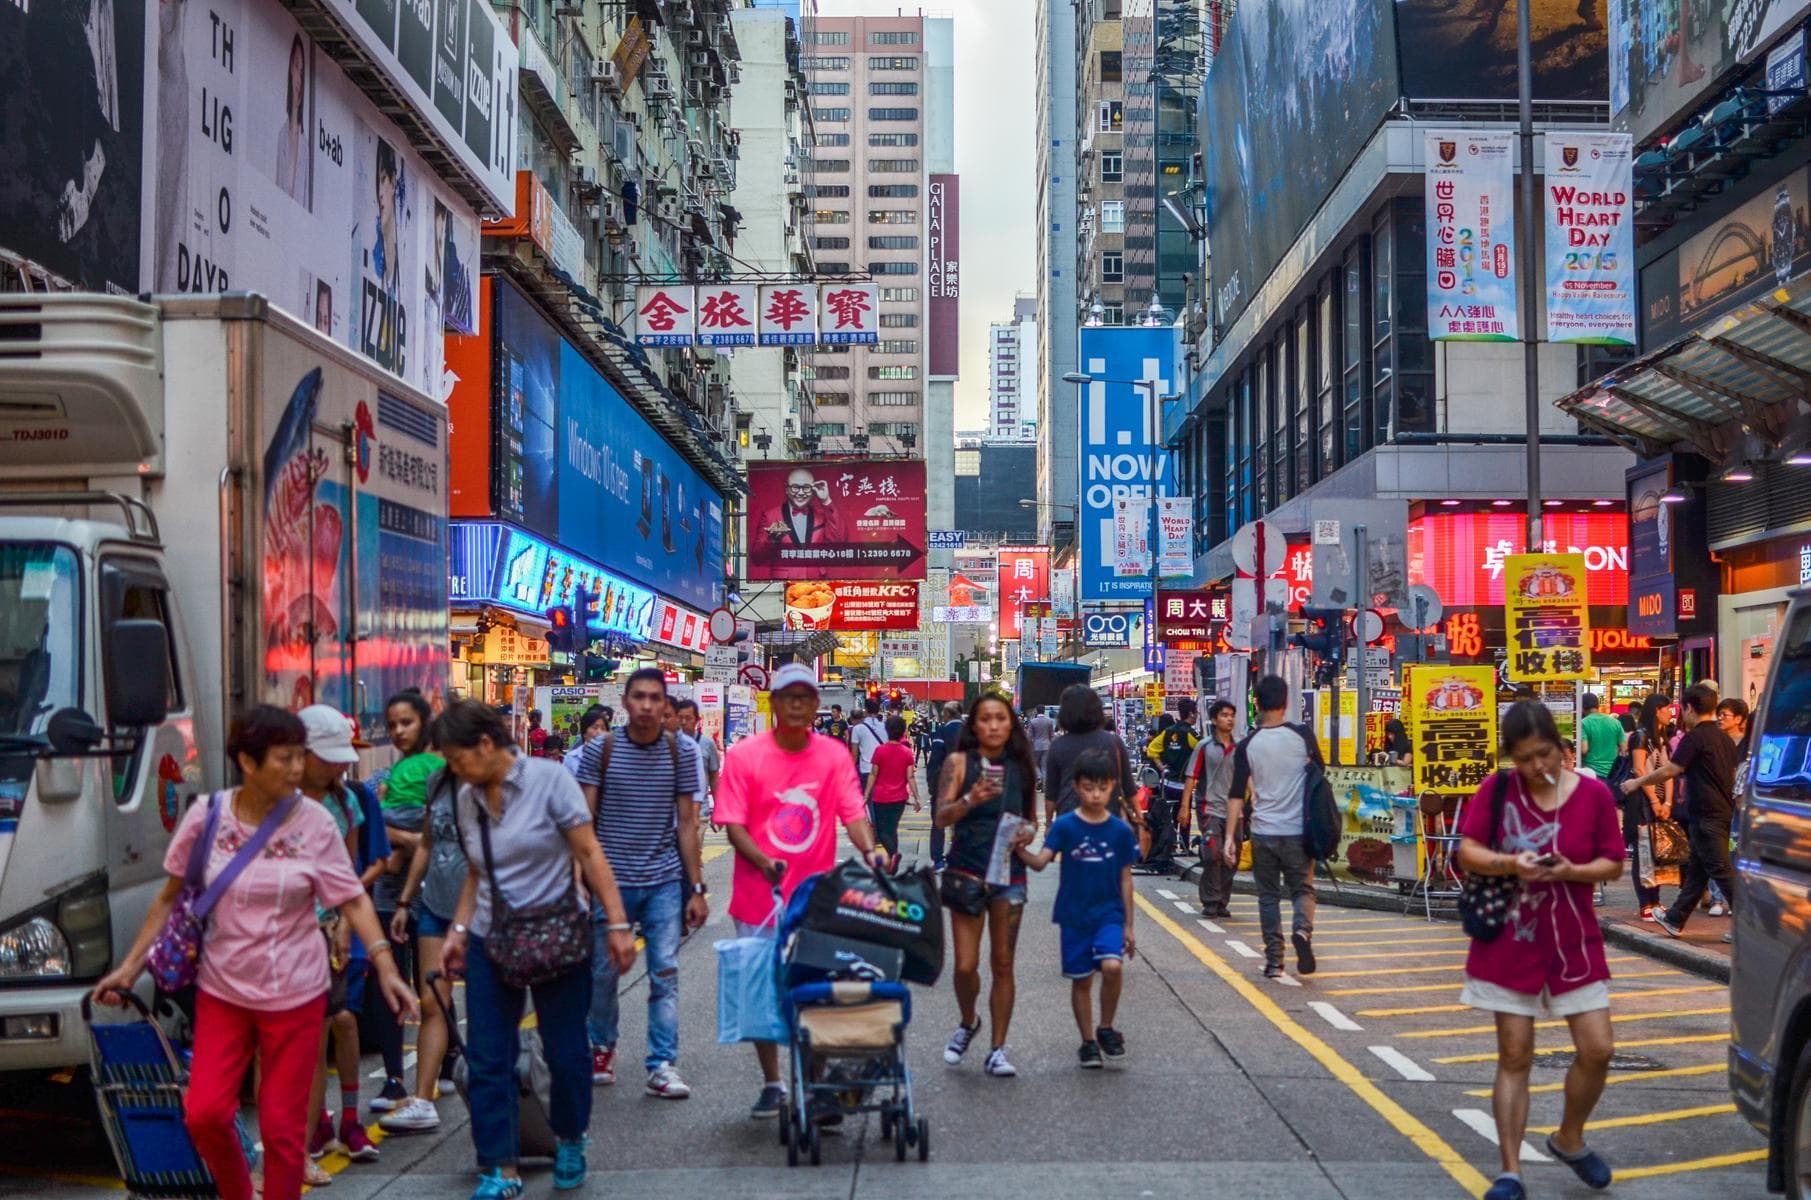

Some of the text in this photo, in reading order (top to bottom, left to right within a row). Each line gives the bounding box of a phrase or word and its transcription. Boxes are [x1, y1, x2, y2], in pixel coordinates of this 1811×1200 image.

[202, 87, 233, 155] LIG
[318, 118, 344, 168] b+ab
[1551, 185, 1626, 206] WORLD
[218, 186, 231, 235] O
[1557, 207, 1621, 227] HEART
[929, 182, 941, 297] GALA PLACE
[1568, 228, 1610, 247] DAY
[1565, 252, 1617, 271] 2015
[1574, 281, 1613, 289] November
[1439, 304, 1495, 319] 人人強心
[1551, 312, 1574, 320] Healthy
[1588, 321, 1633, 329] everywhere
[1088, 358, 1169, 445] i.t
[1089, 454, 1167, 481] NOW
[1161, 516, 1190, 525] WORLD
[929, 532, 962, 542] EASY
[1168, 532, 1184, 540] DAY
[449, 575, 466, 595] RE
[1166, 599, 1226, 618] 周大福
[1638, 592, 1663, 617] MIDO
[1166, 628, 1205, 636] CHOW TAI
[729, 656, 737, 665] 10
[1378, 658, 1388, 666] 10
[1380, 678, 1389, 686] 10
[551, 688, 586, 696] CASIO
